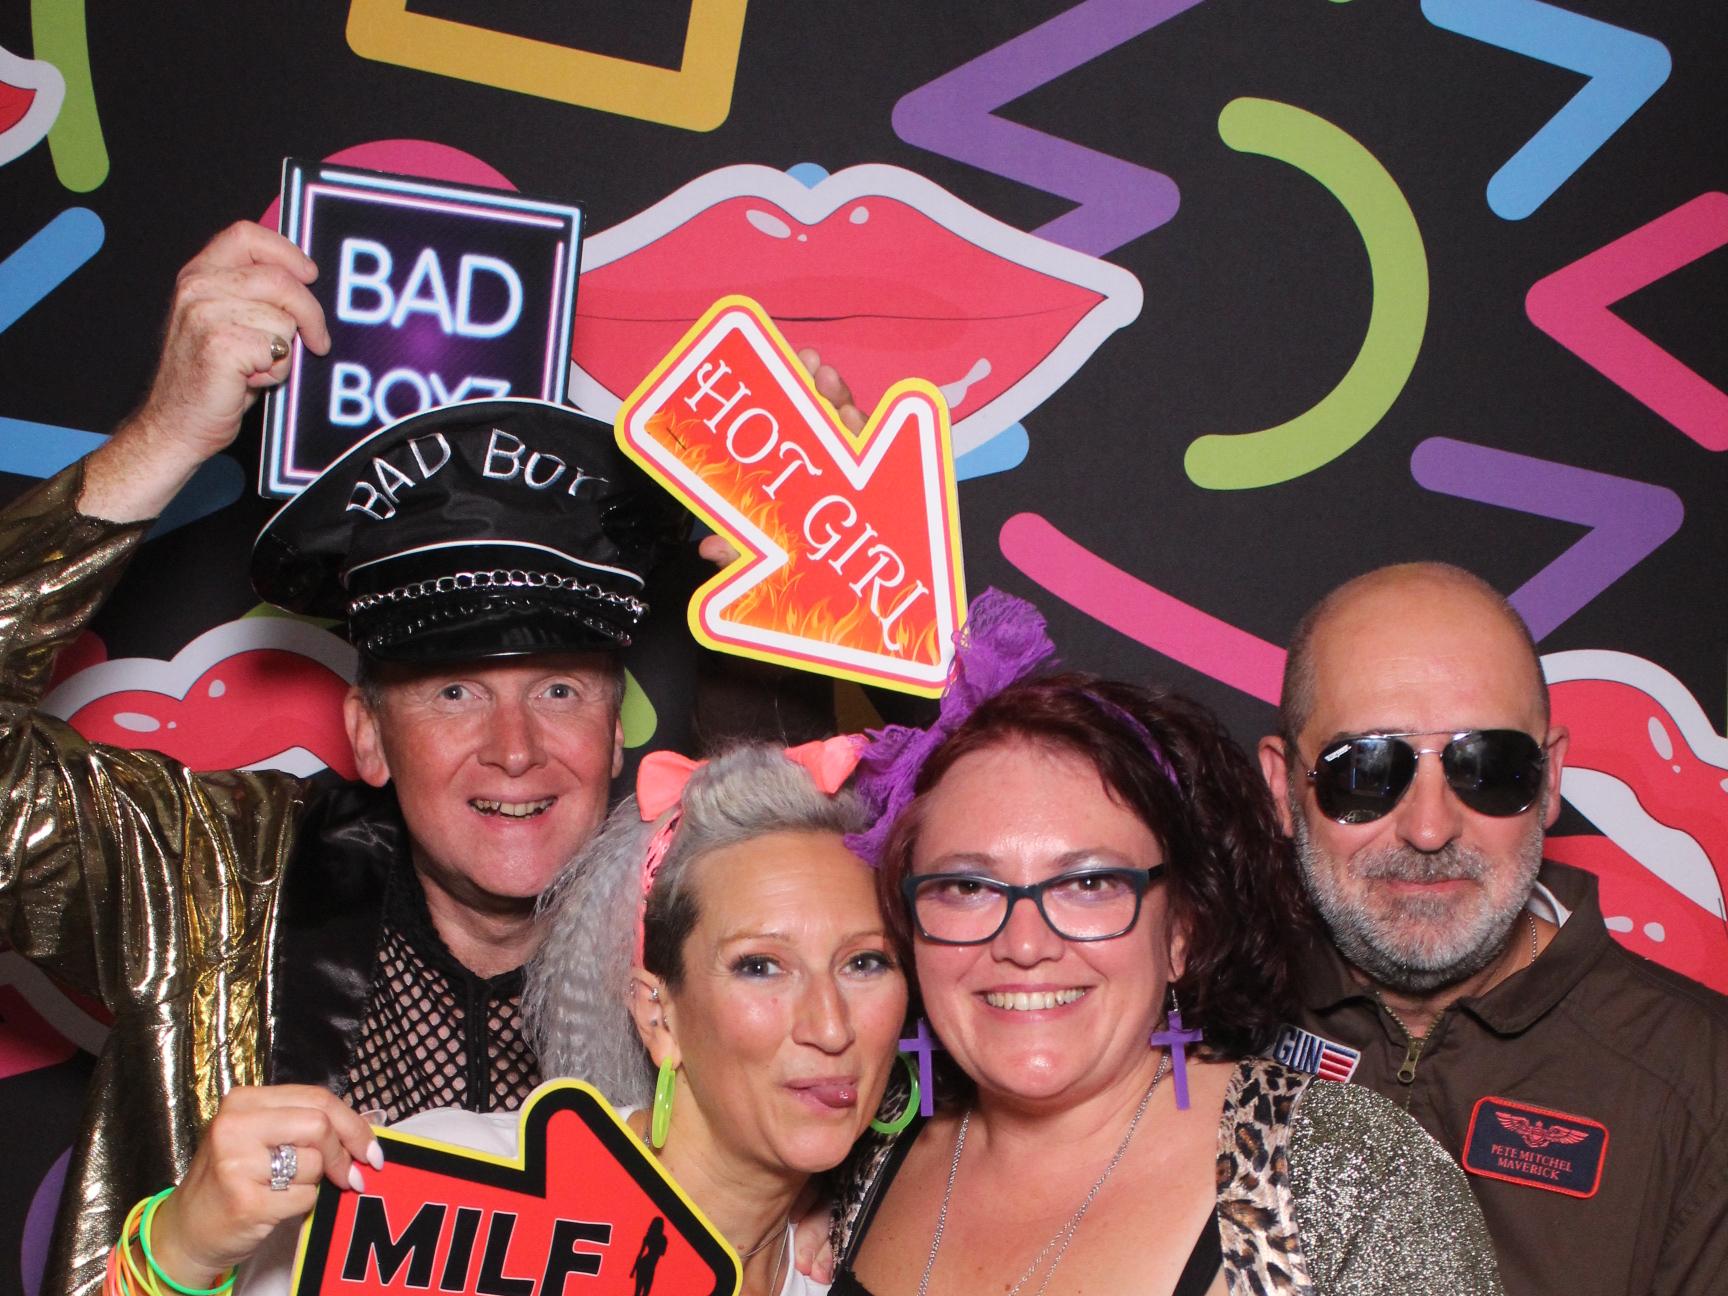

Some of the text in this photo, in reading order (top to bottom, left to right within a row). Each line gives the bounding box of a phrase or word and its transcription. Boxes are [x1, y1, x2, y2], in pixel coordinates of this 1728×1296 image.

[335, 237, 524, 339] BAD
[345, 428, 611, 520] BAD BOY
[683, 359, 929, 651] HOT GIRL
[1491, 1143, 1573, 1173] PETE MITCHEL
[1497, 1157, 1561, 1180] MAVERICK
